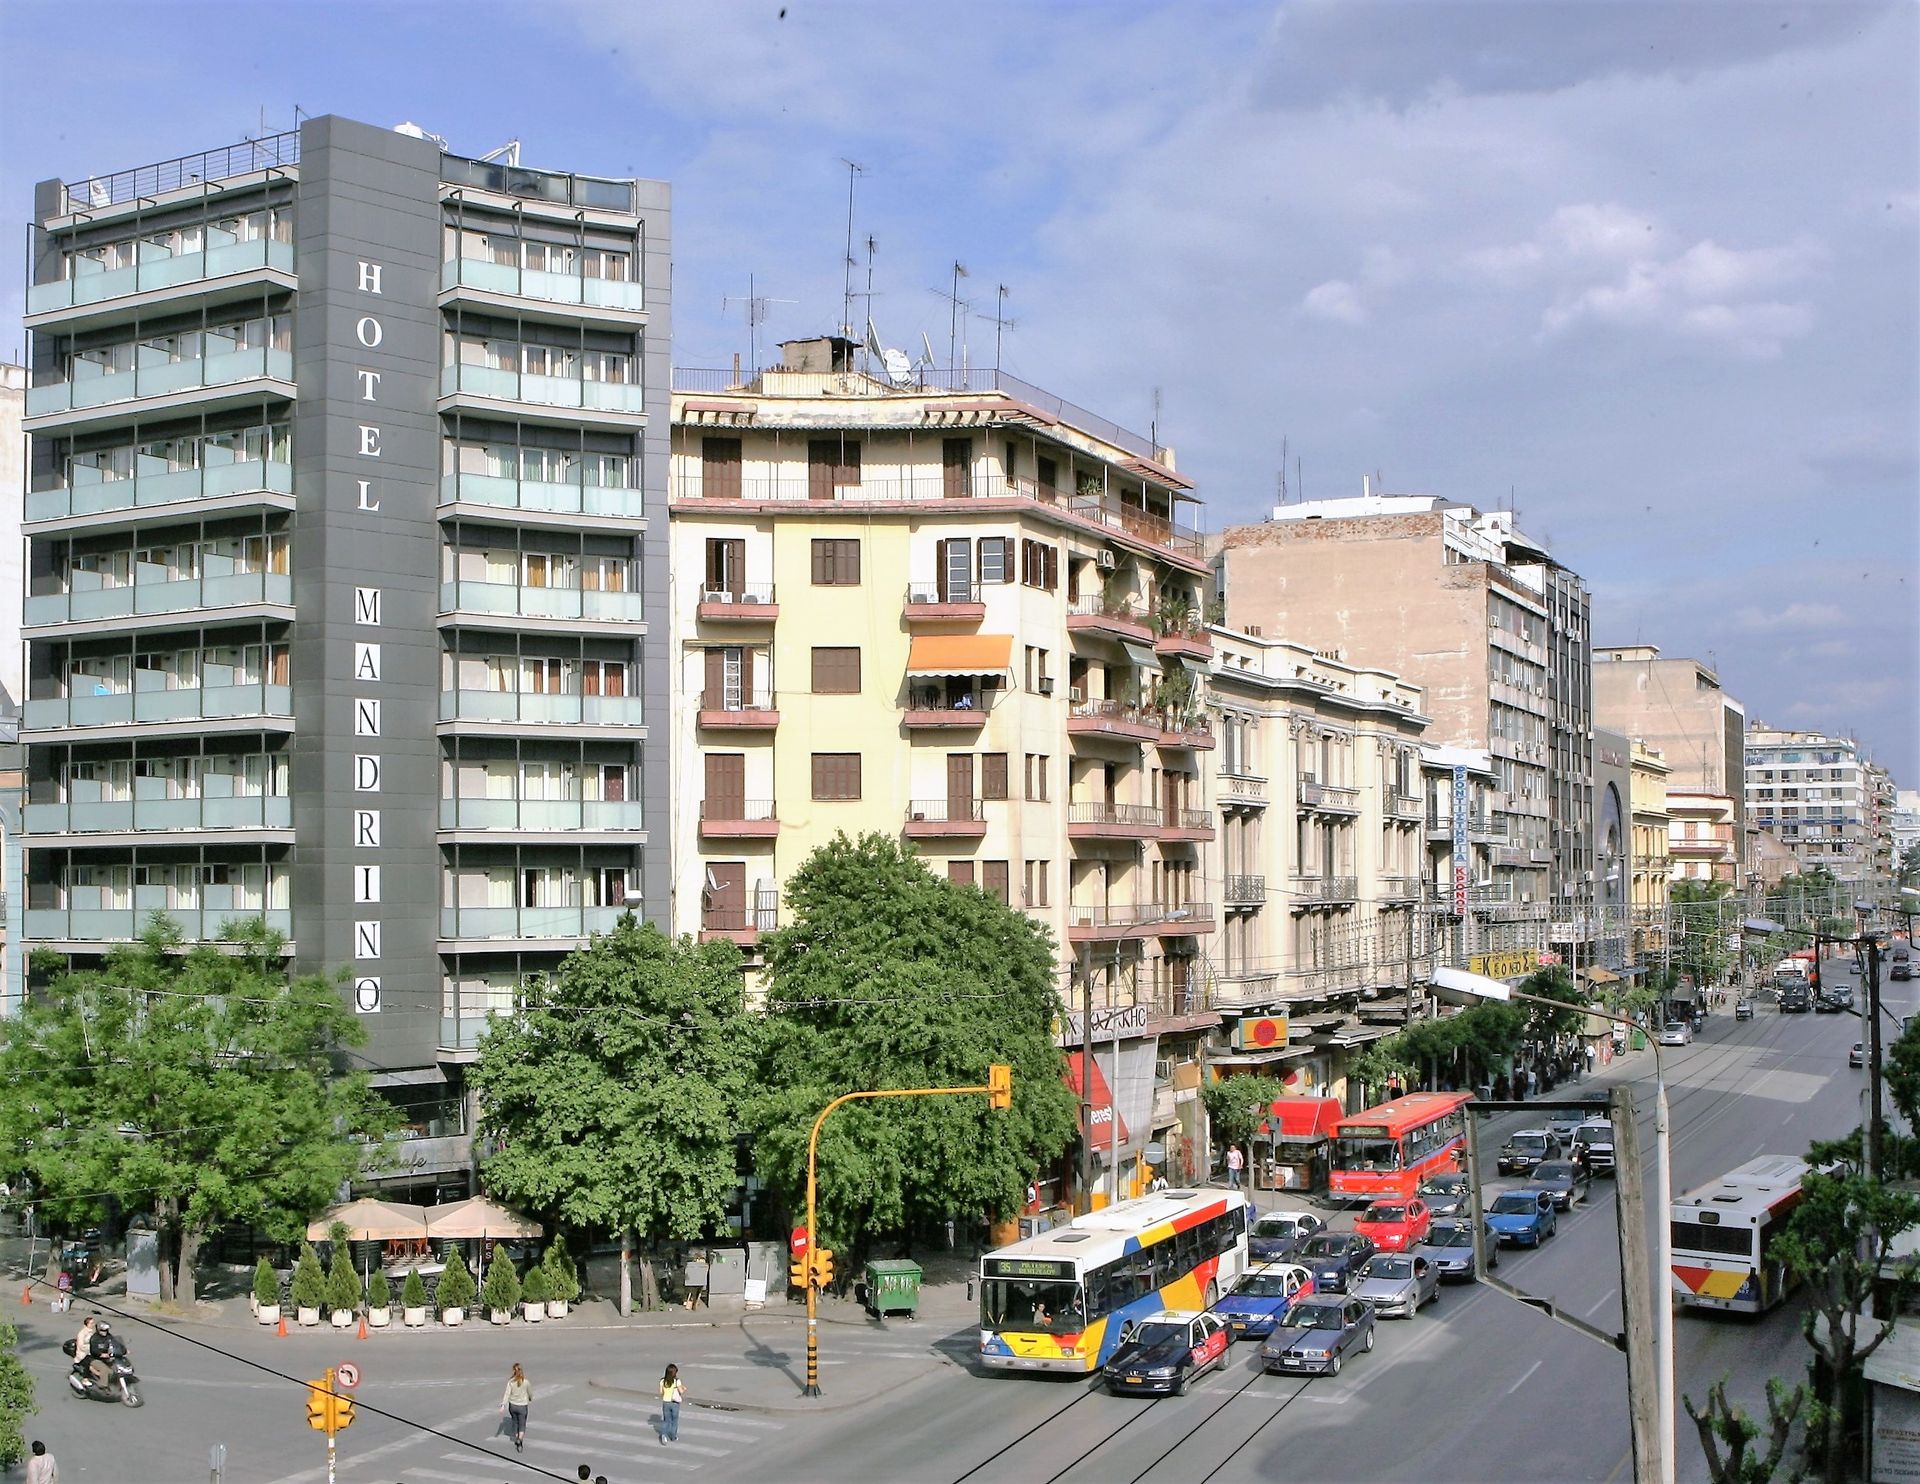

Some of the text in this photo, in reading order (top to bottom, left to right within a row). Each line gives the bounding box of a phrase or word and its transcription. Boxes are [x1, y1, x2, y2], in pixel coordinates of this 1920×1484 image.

[357, 261, 383, 512] HOTEL
[356, 588, 380, 1012] MANDRINO
[1454, 766, 1466, 861] ΦΡΟΝΤΙΣΤΗΡΙΑ
[1455, 867, 1466, 915] ΚΡΟΝΟΣ
[1000, 1261, 1011, 1273] 35
